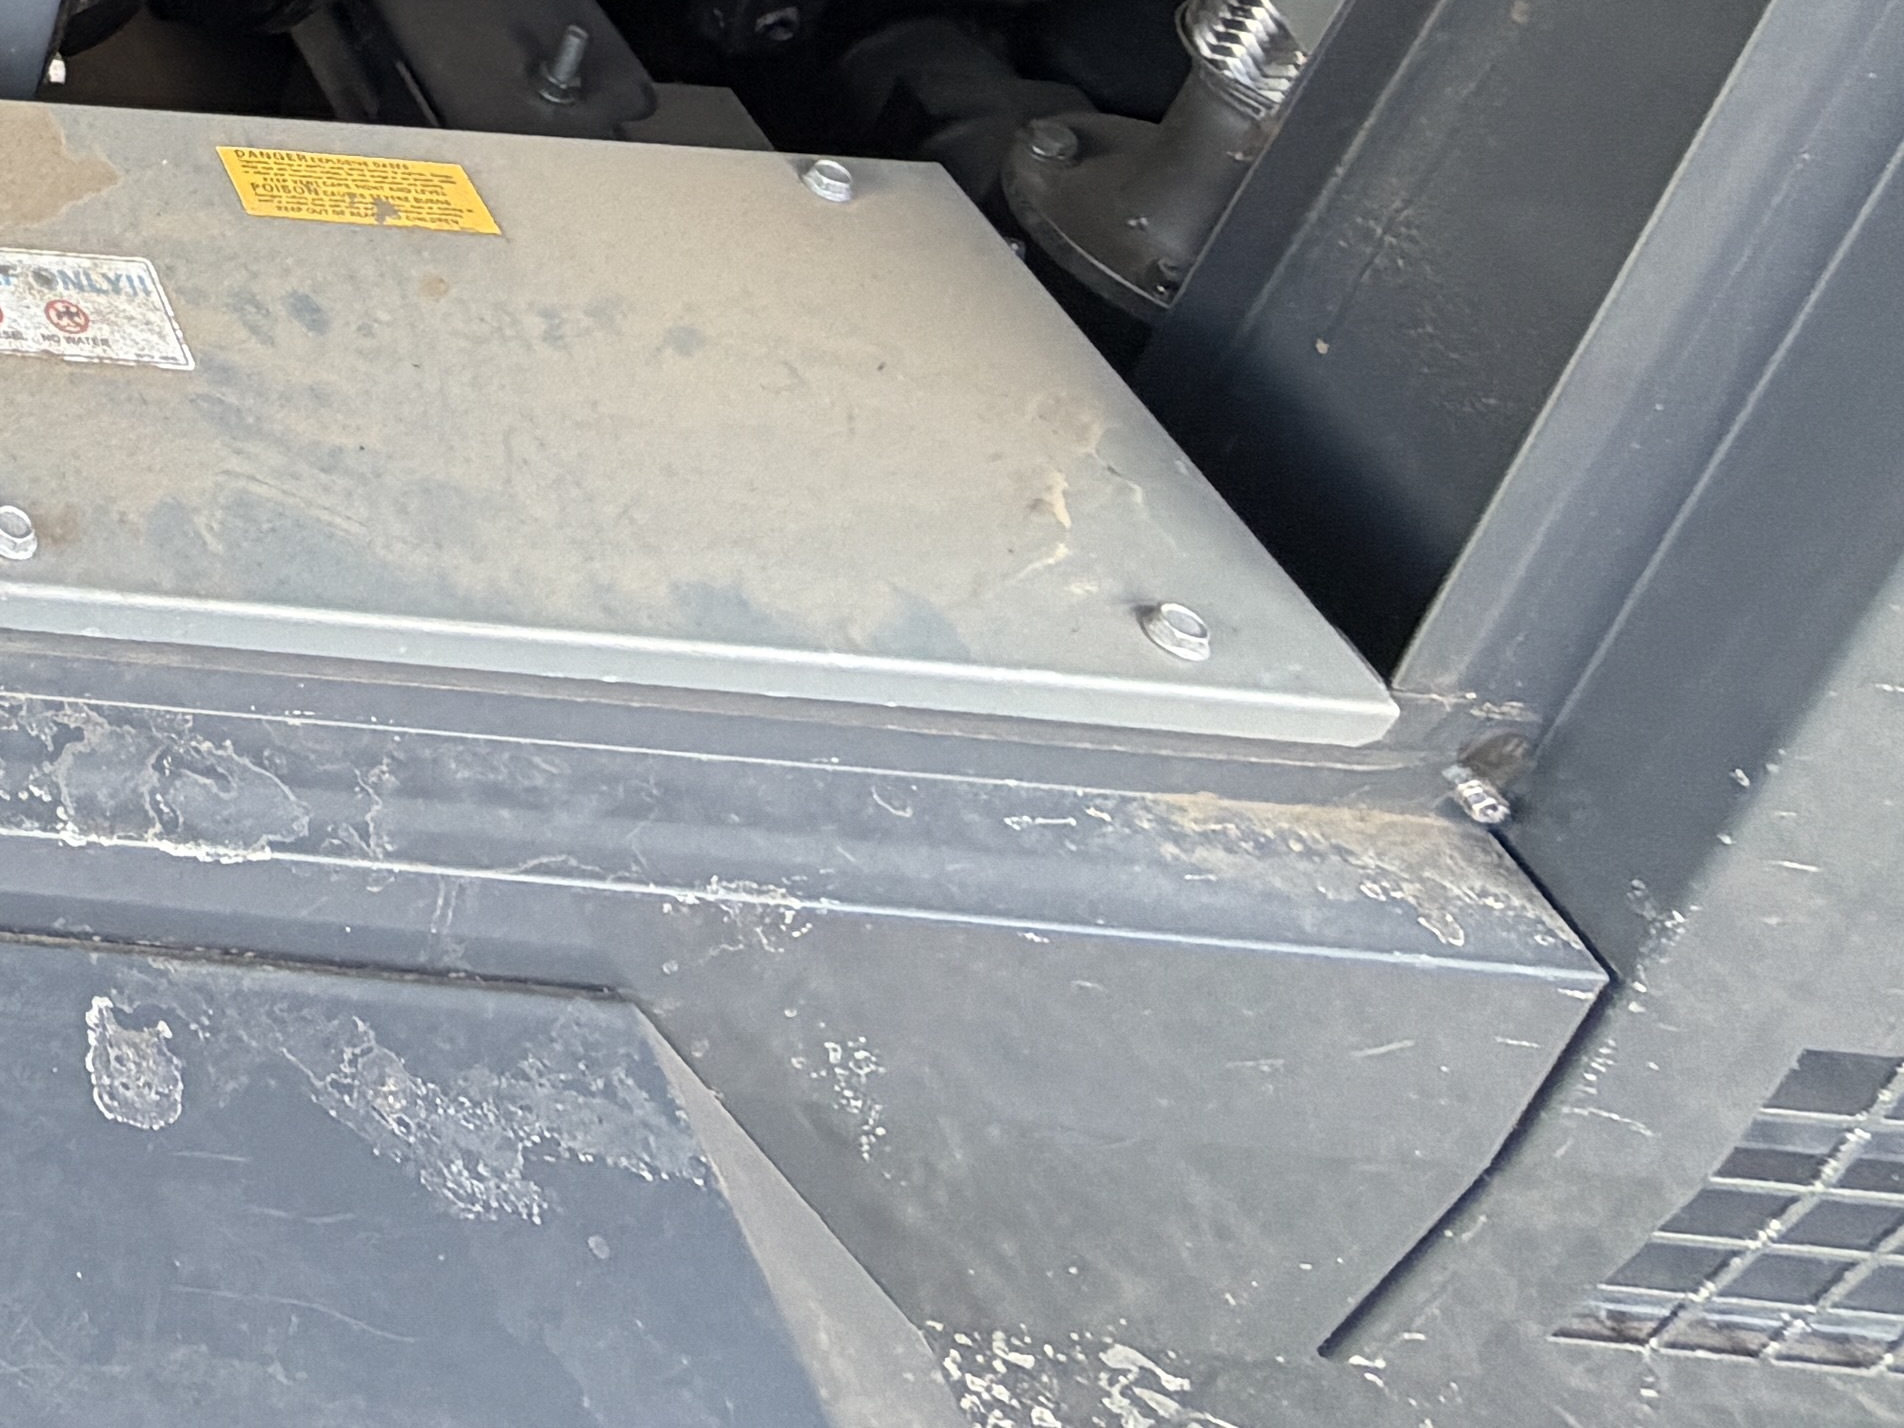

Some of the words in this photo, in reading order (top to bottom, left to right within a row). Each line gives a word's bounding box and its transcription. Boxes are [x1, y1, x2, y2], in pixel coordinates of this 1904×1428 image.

[234, 149, 309, 163] DANGER
[250, 182, 320, 197] POISON
[322, 190, 367, 200] CAUS
[34, 268, 153, 298] ONLY!!
[42, 333, 60, 343] NO
[64, 335, 111, 346] WATER
